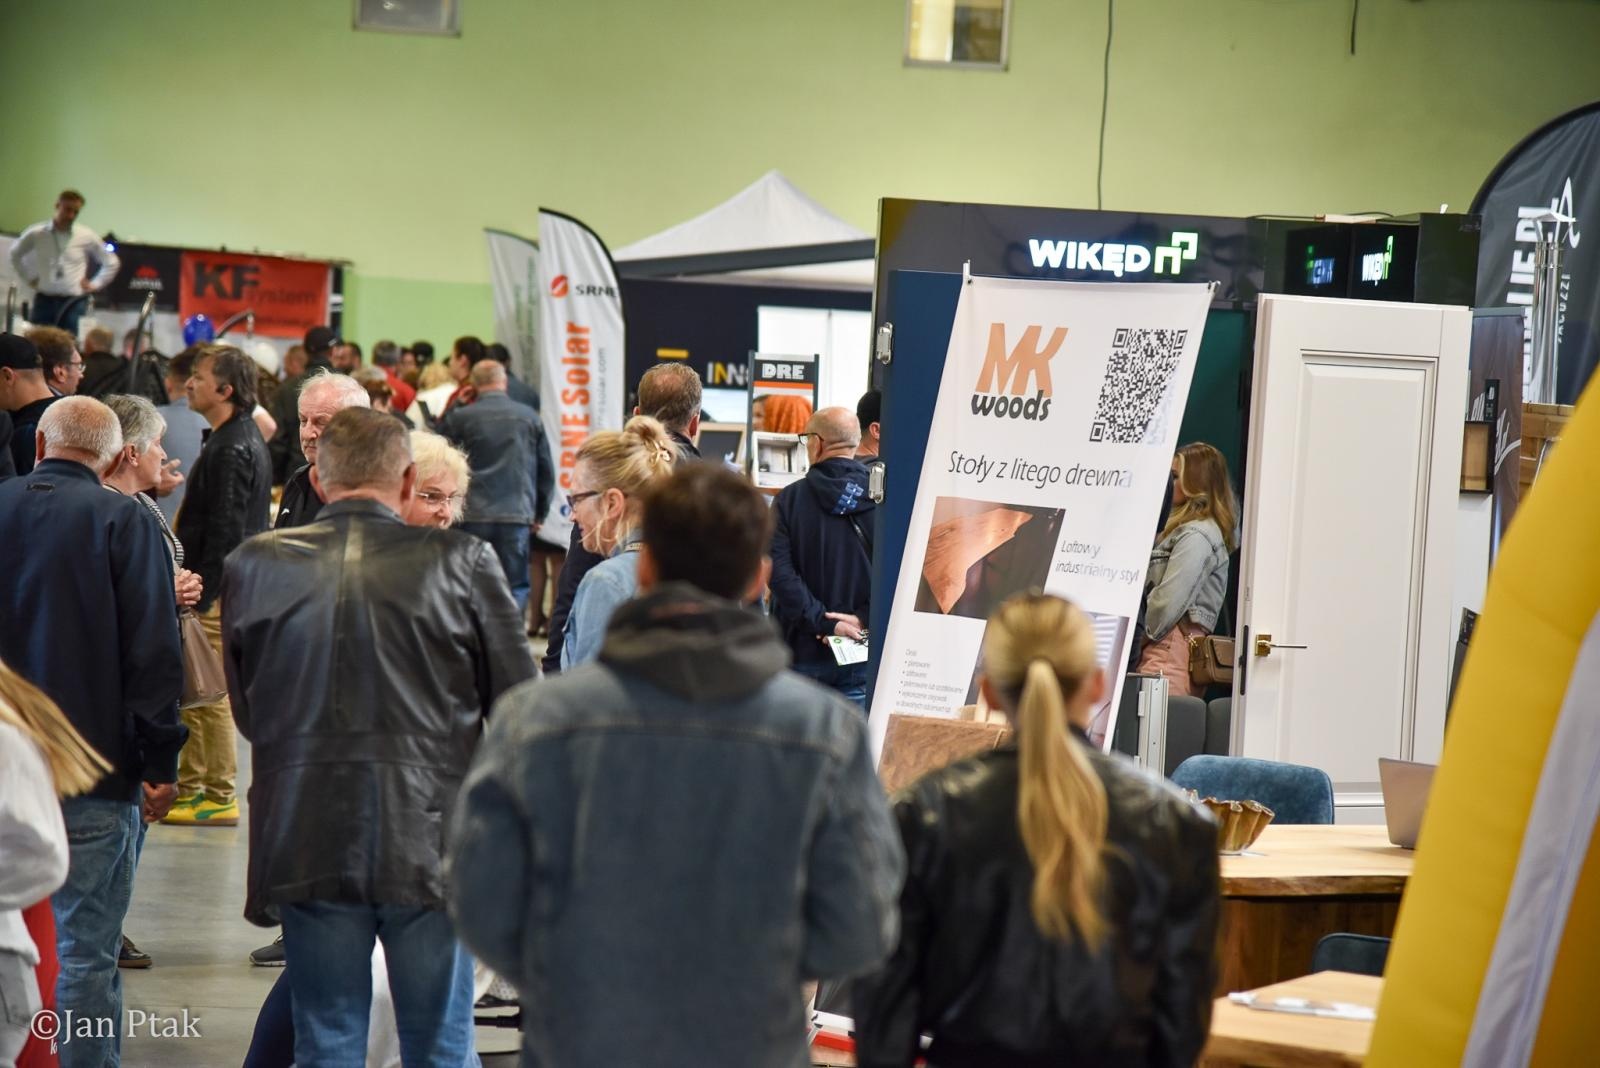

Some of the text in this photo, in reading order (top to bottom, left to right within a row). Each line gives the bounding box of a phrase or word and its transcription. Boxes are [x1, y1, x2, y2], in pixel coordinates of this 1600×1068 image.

[1028, 238, 1151, 277] WIKĘD
[193, 262, 261, 301] KF
[561, 321, 591, 407] Solar
[707, 361, 748, 386] INN
[762, 363, 804, 380] DRE
[974, 322, 1068, 397] MK
[971, 390, 1051, 421] woods
[947, 450, 1131, 490] Stoły z litego drewna
[1061, 540, 1102, 559] Loftowy
